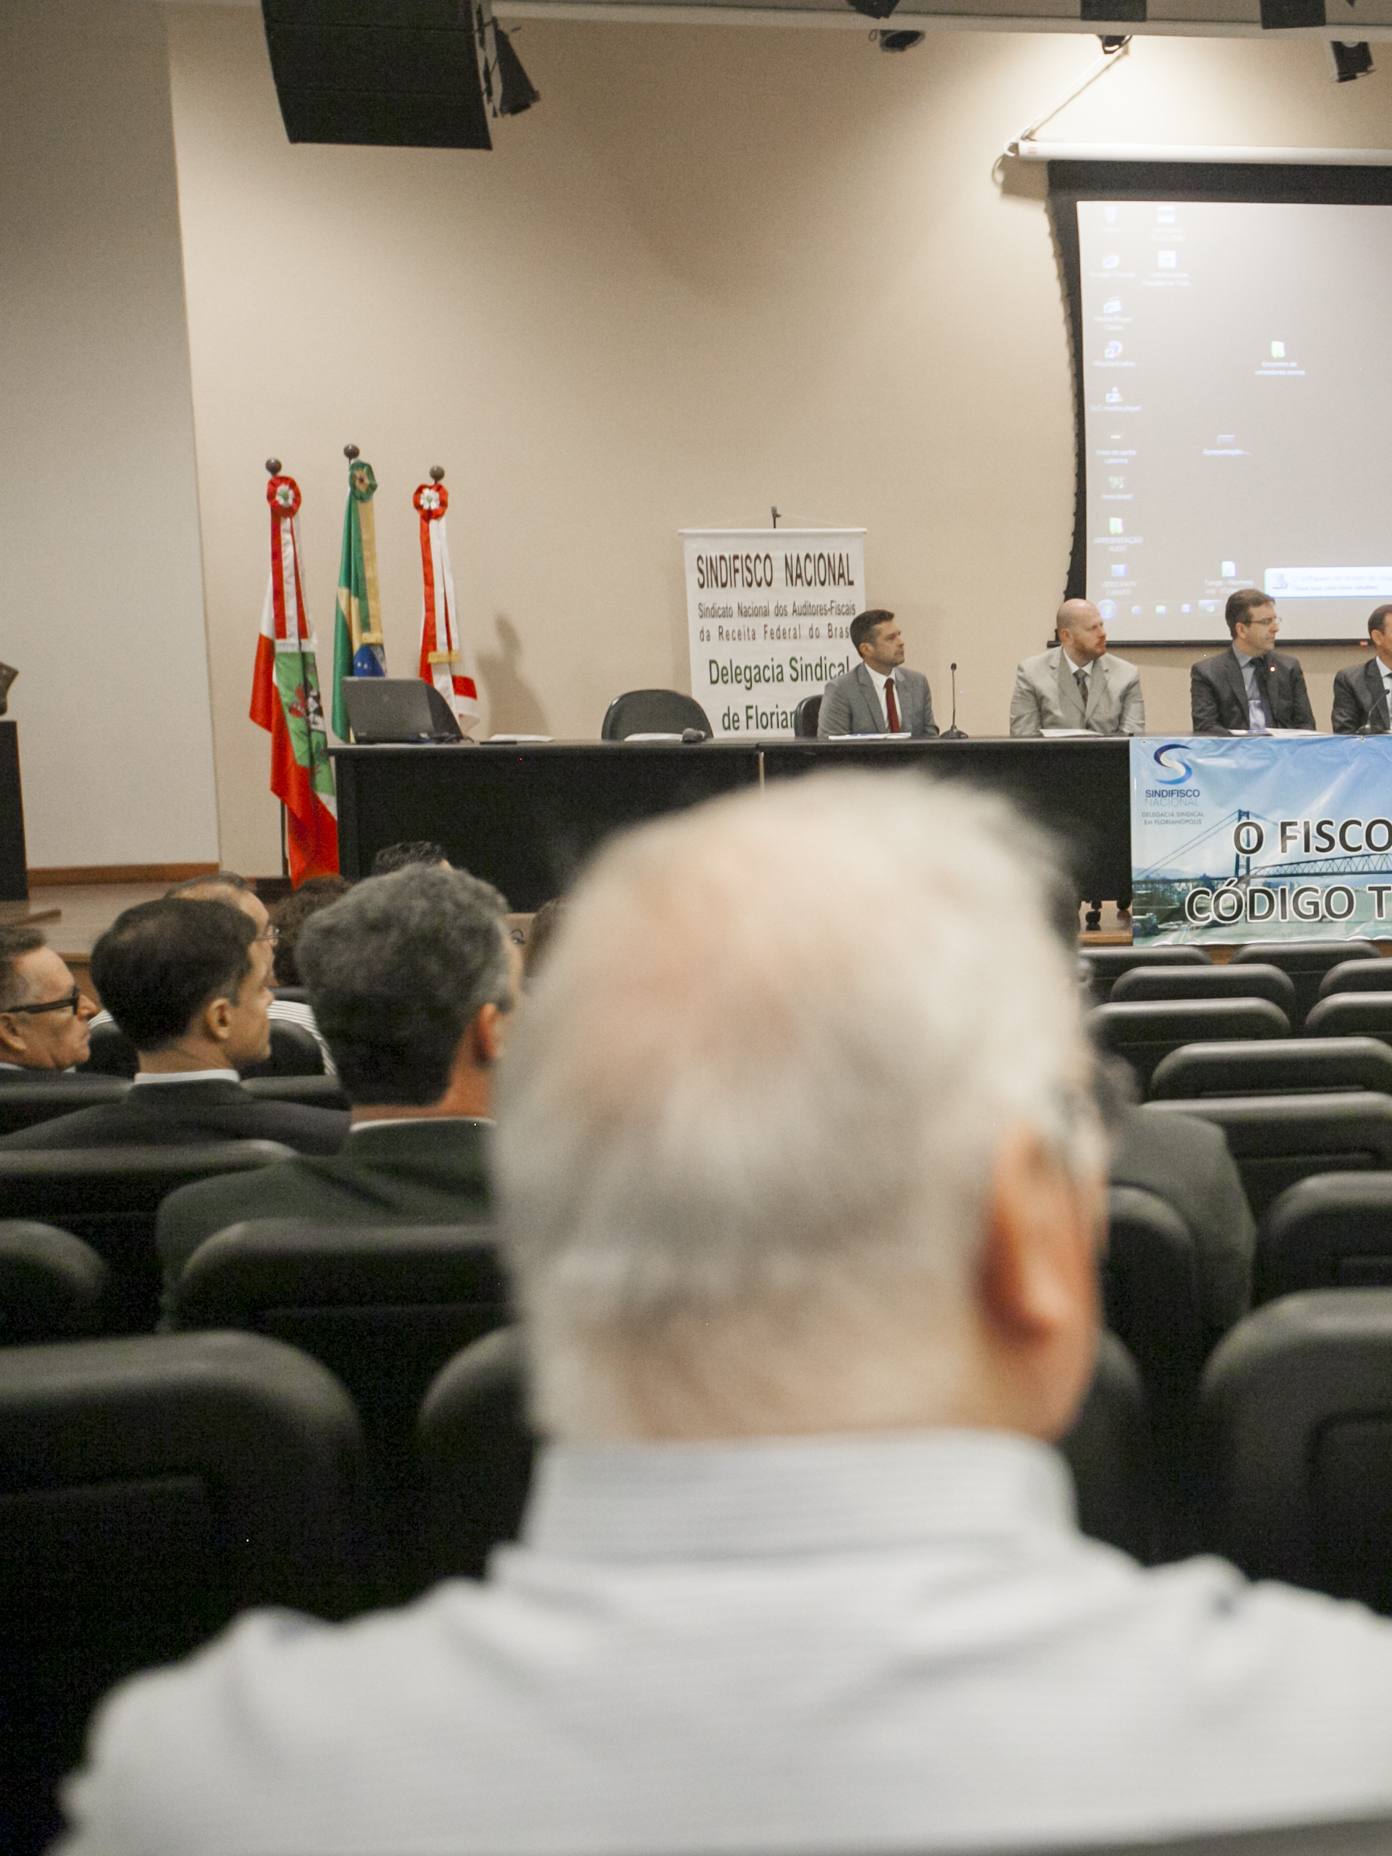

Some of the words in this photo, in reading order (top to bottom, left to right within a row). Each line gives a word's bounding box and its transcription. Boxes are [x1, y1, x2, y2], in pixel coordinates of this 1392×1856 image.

[696, 553, 773, 589] SINDIFISCO
[784, 552, 855, 588] NACIONAL
[698, 601, 734, 619] Sindicato
[737, 601, 770, 618] Nacional
[774, 601, 788, 617] dos
[792, 600, 856, 616] Auditores-Fiscais
[700, 625, 711, 641] da
[718, 624, 756, 641] Receita
[763, 623, 802, 640] Federal
[808, 622, 820, 639] do
[827, 622, 850, 639] Bras
[708, 656, 784, 690] Delegacia
[788, 655, 850, 682] Sindical
[722, 705, 740, 731] de
[745, 704, 797, 730] Florian
[1144, 798, 1201, 807] NACIONAL
[1145, 789, 1201, 798] SINDIFISCO
[1234, 820, 1264, 855] O
[1185, 878, 1356, 925] CÓDIGO
